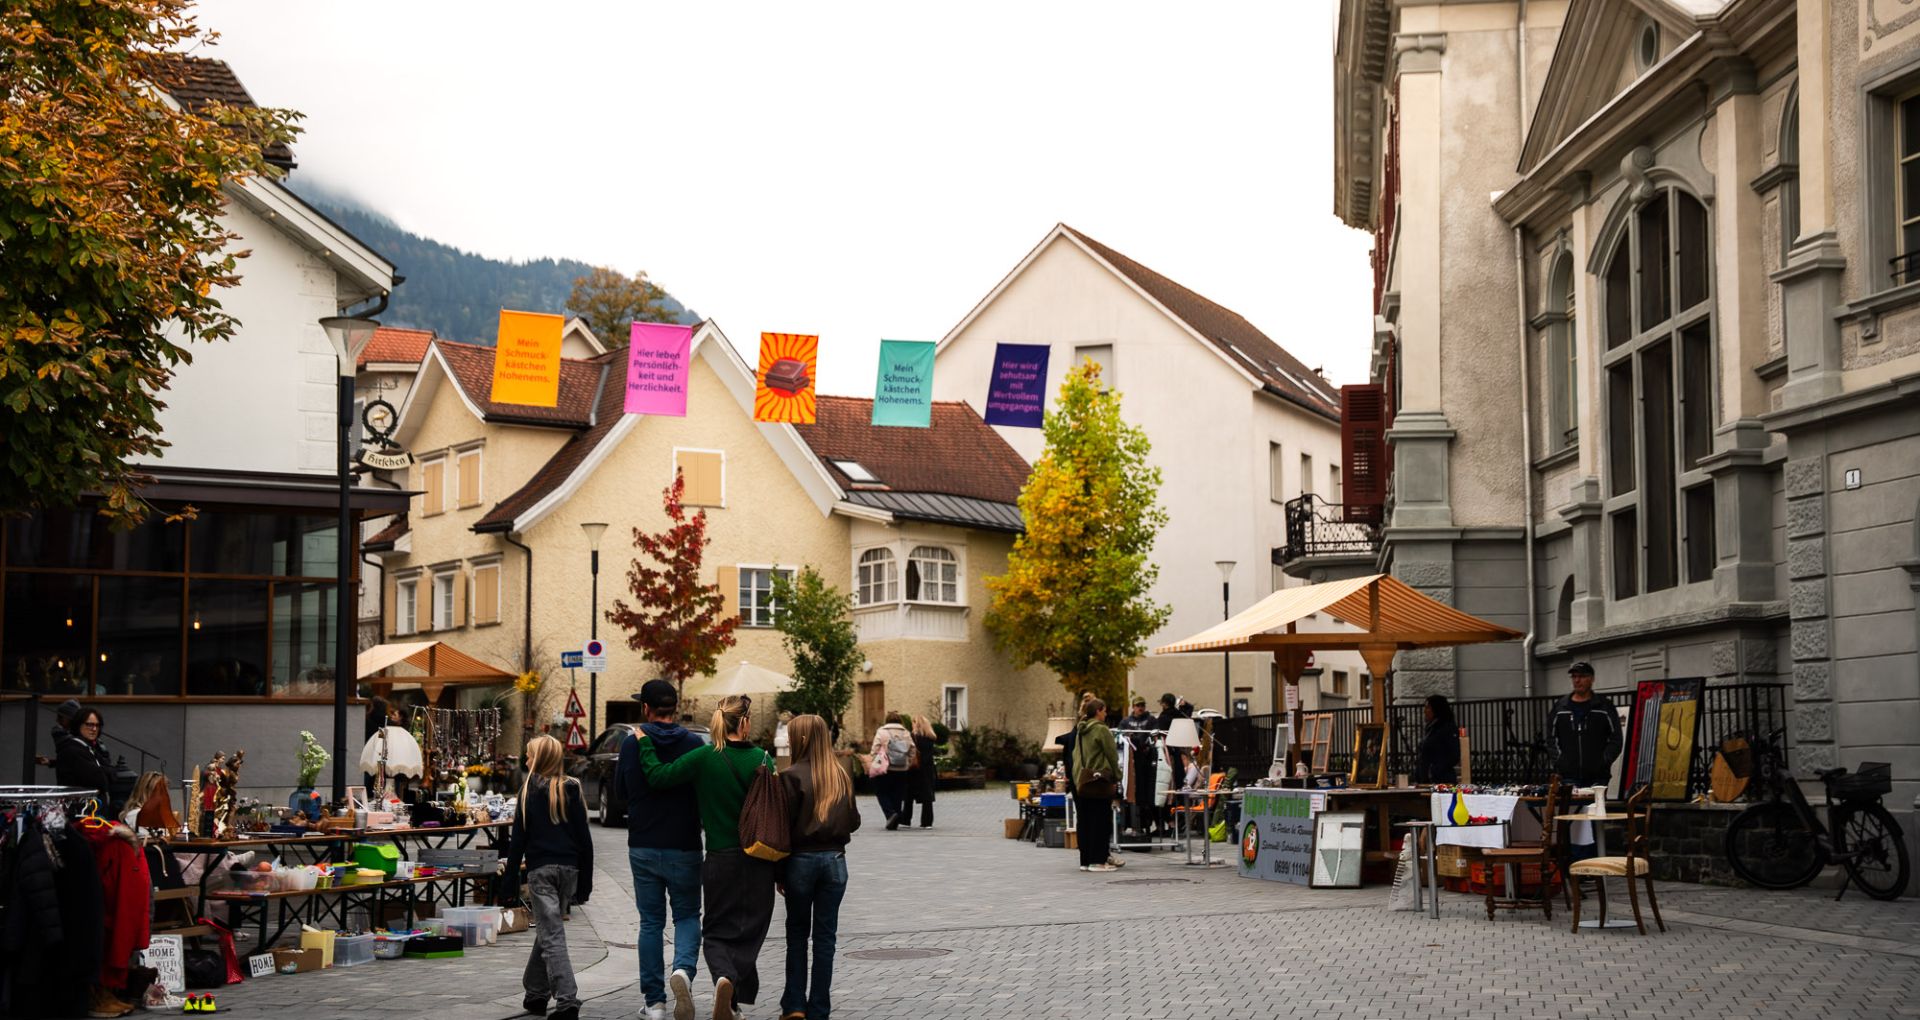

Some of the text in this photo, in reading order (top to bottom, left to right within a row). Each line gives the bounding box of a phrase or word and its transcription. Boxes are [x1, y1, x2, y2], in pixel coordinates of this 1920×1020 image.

[517, 338, 539, 347] Mein
[637, 349, 680, 359] Hier leben
[633, 360, 682, 370] Persönlich-
[894, 364, 913, 373] Mein
[639, 371, 674, 381] keit und
[883, 374, 923, 383] Schmuck-
[883, 384, 920, 393] kästchen
[879, 395, 924, 405] Hohenems.
[149, 948, 175, 957] HOME
[251, 956, 274, 974] HOME
